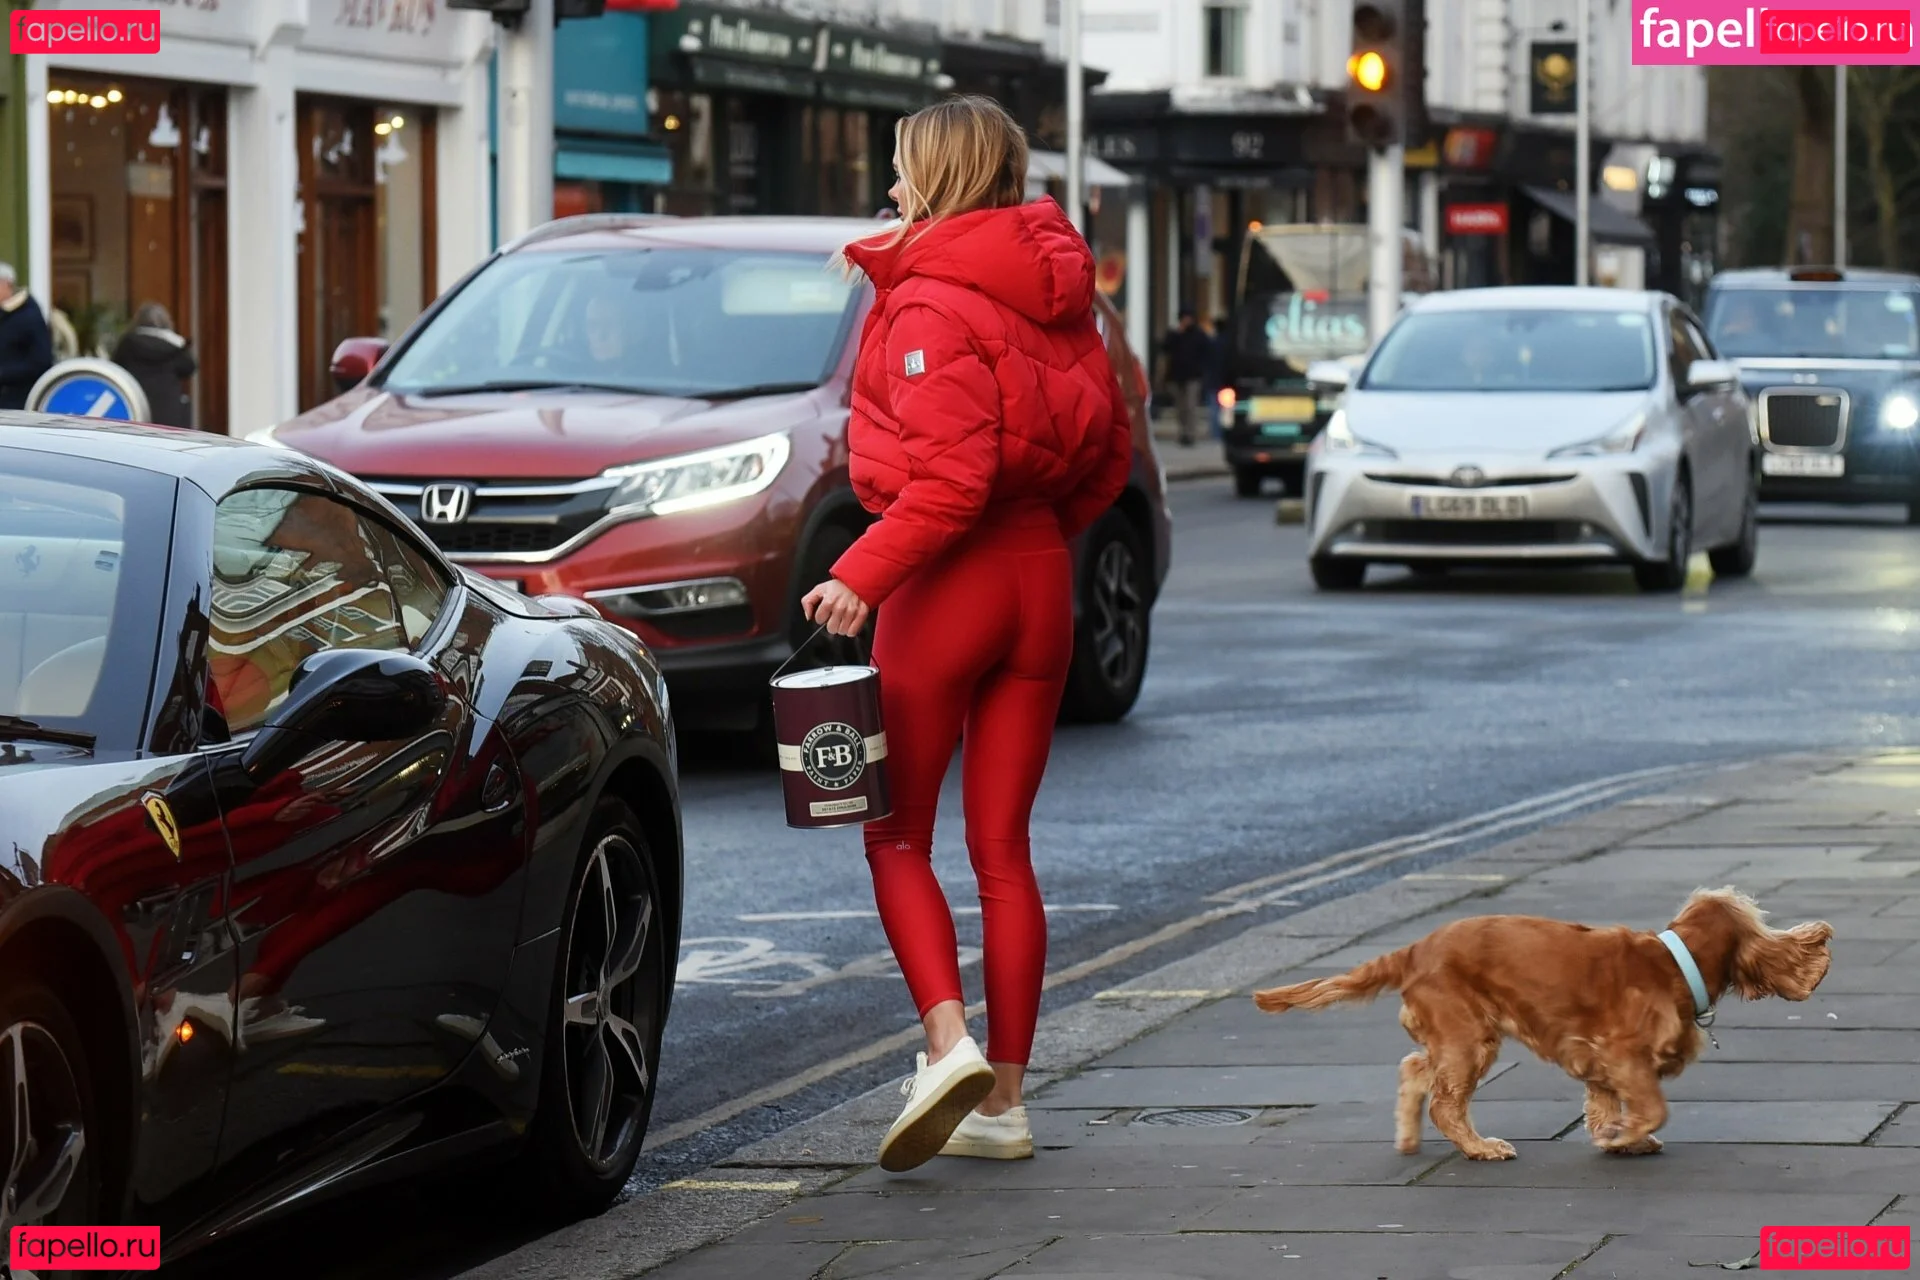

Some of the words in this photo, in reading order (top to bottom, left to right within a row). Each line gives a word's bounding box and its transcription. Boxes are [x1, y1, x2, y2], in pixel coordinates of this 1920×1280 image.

[803, 724, 832, 754] FARROW
[844, 727, 861, 749] BALL
[815, 744, 852, 768] F&B
[806, 765, 829, 787] PAINT
[896, 840, 910, 850] alo
